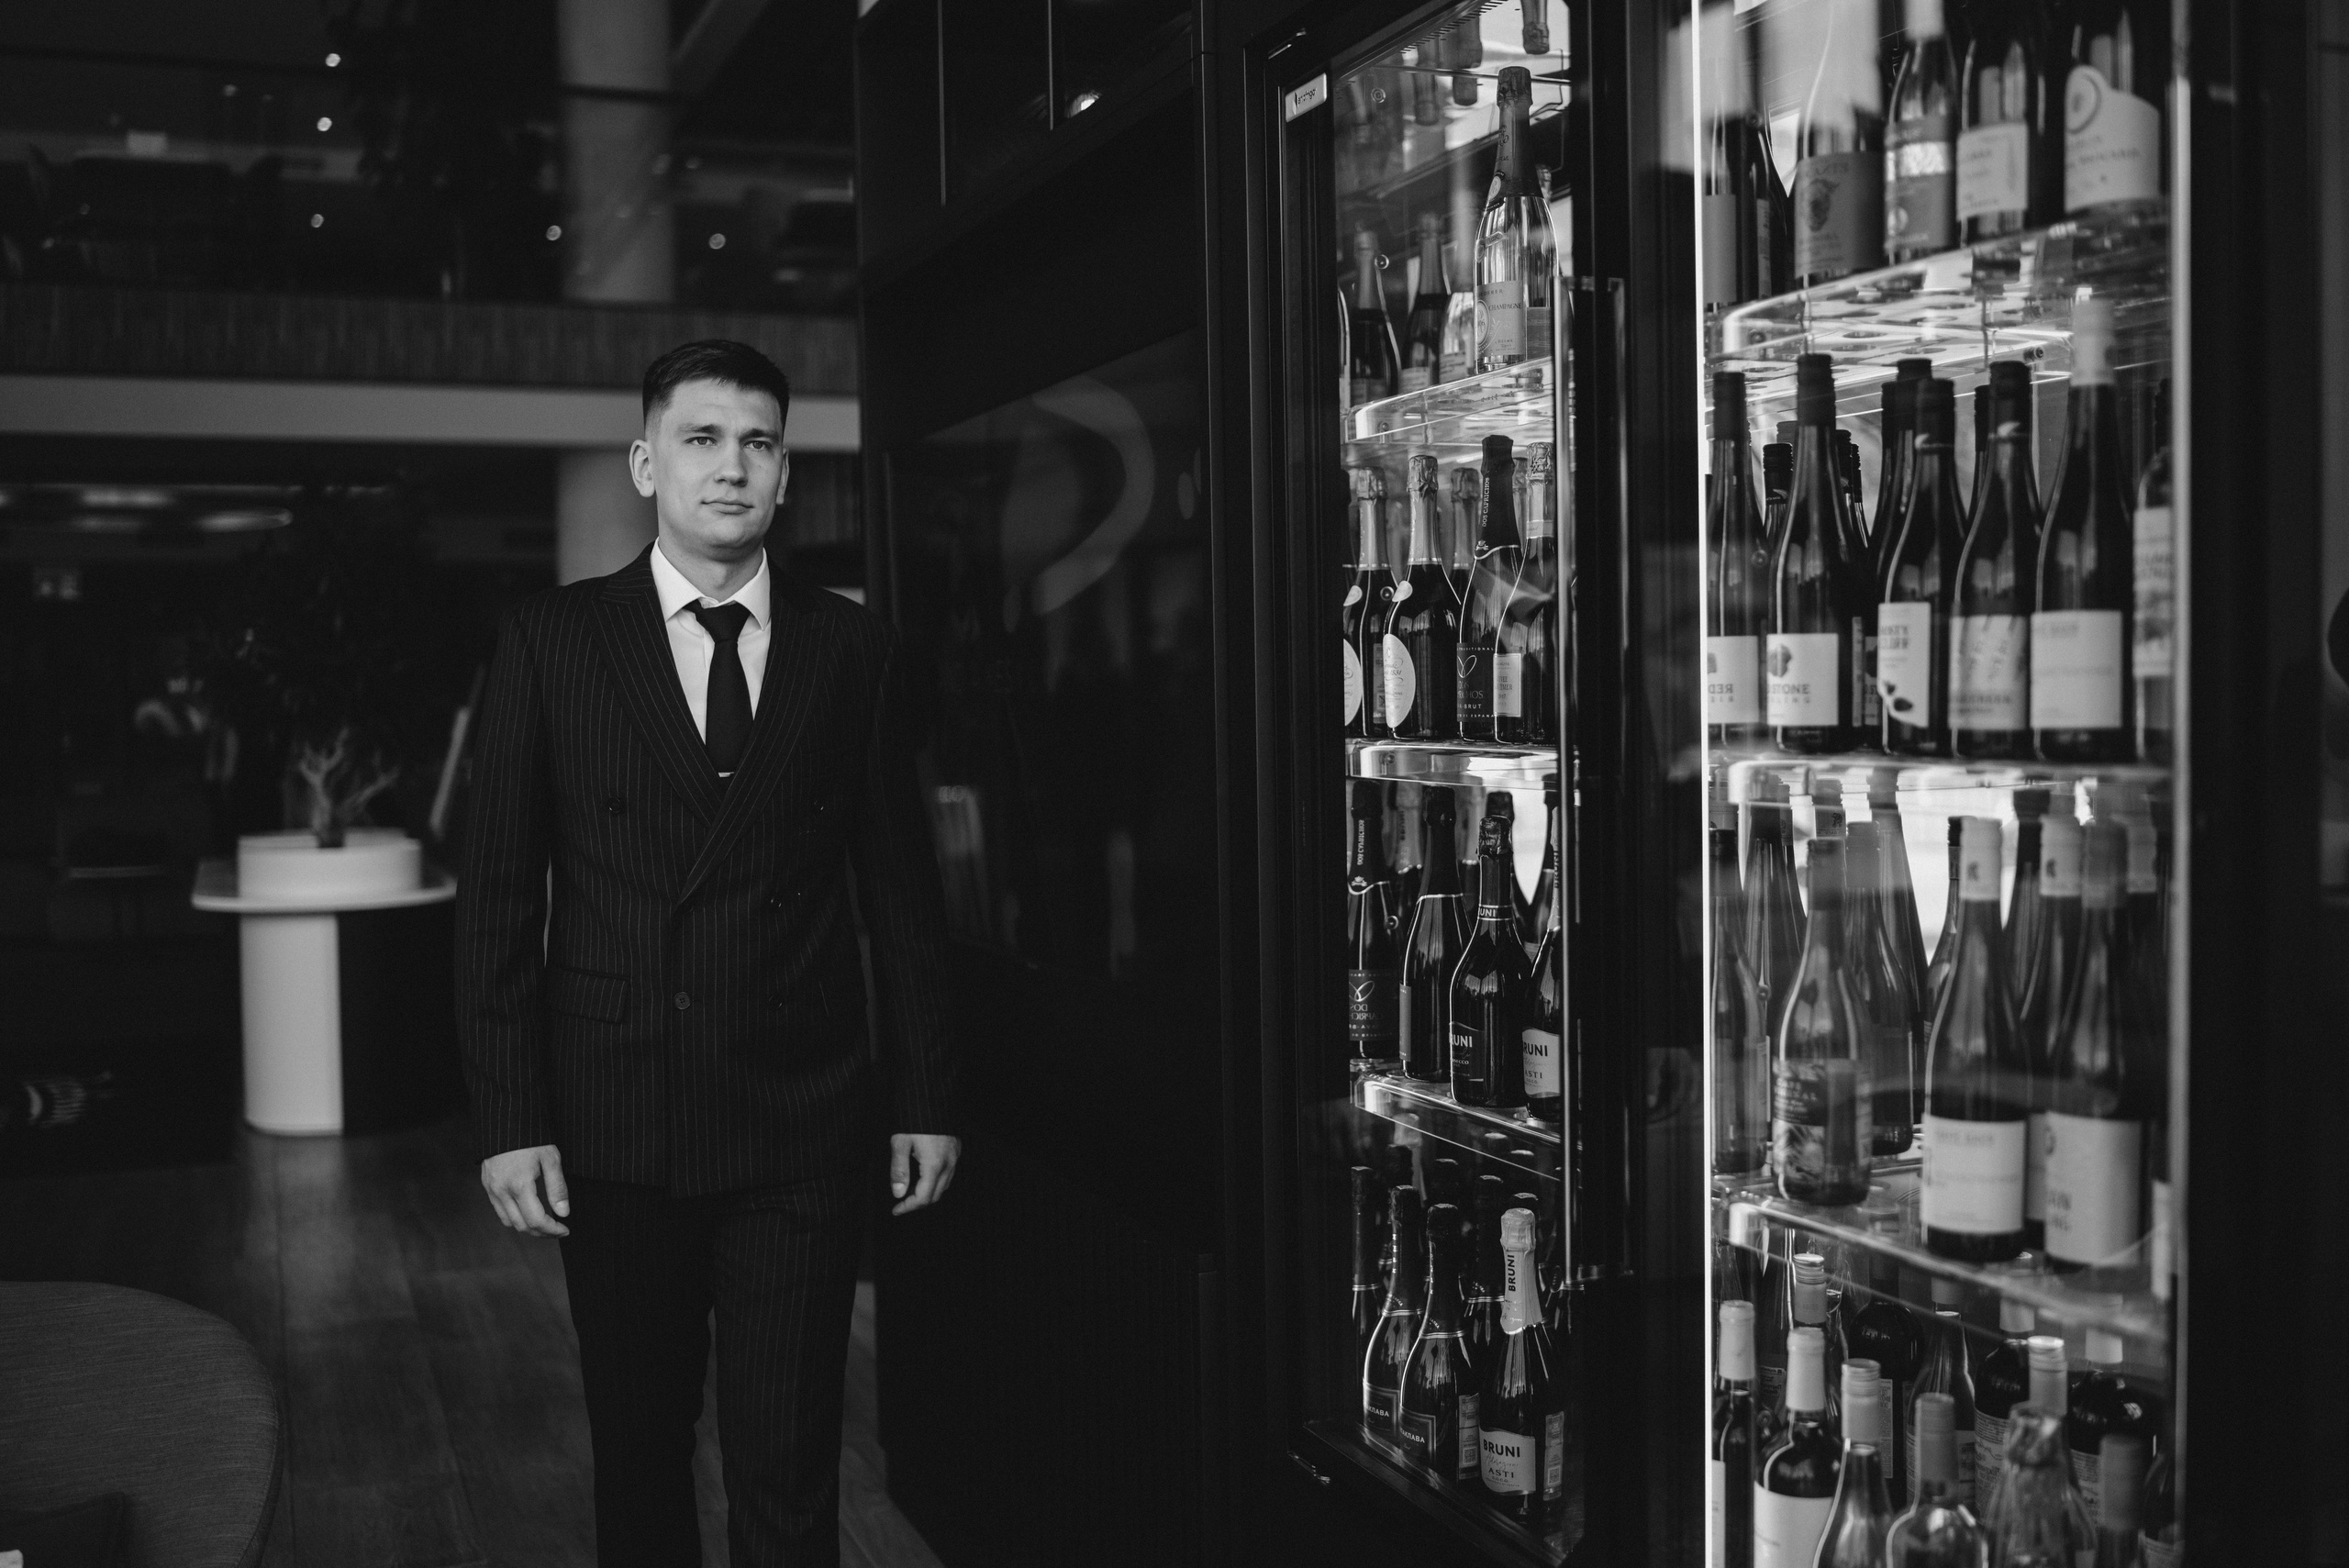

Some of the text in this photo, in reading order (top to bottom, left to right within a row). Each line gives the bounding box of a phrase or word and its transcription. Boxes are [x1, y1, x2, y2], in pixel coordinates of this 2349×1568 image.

[1488, 302, 1523, 312] CHAMPAGNE
[1507, 1254, 1517, 1292] BRUNI
[1483, 1439, 1520, 1458] BRUNI
[1488, 1467, 1515, 1479] ASTI
